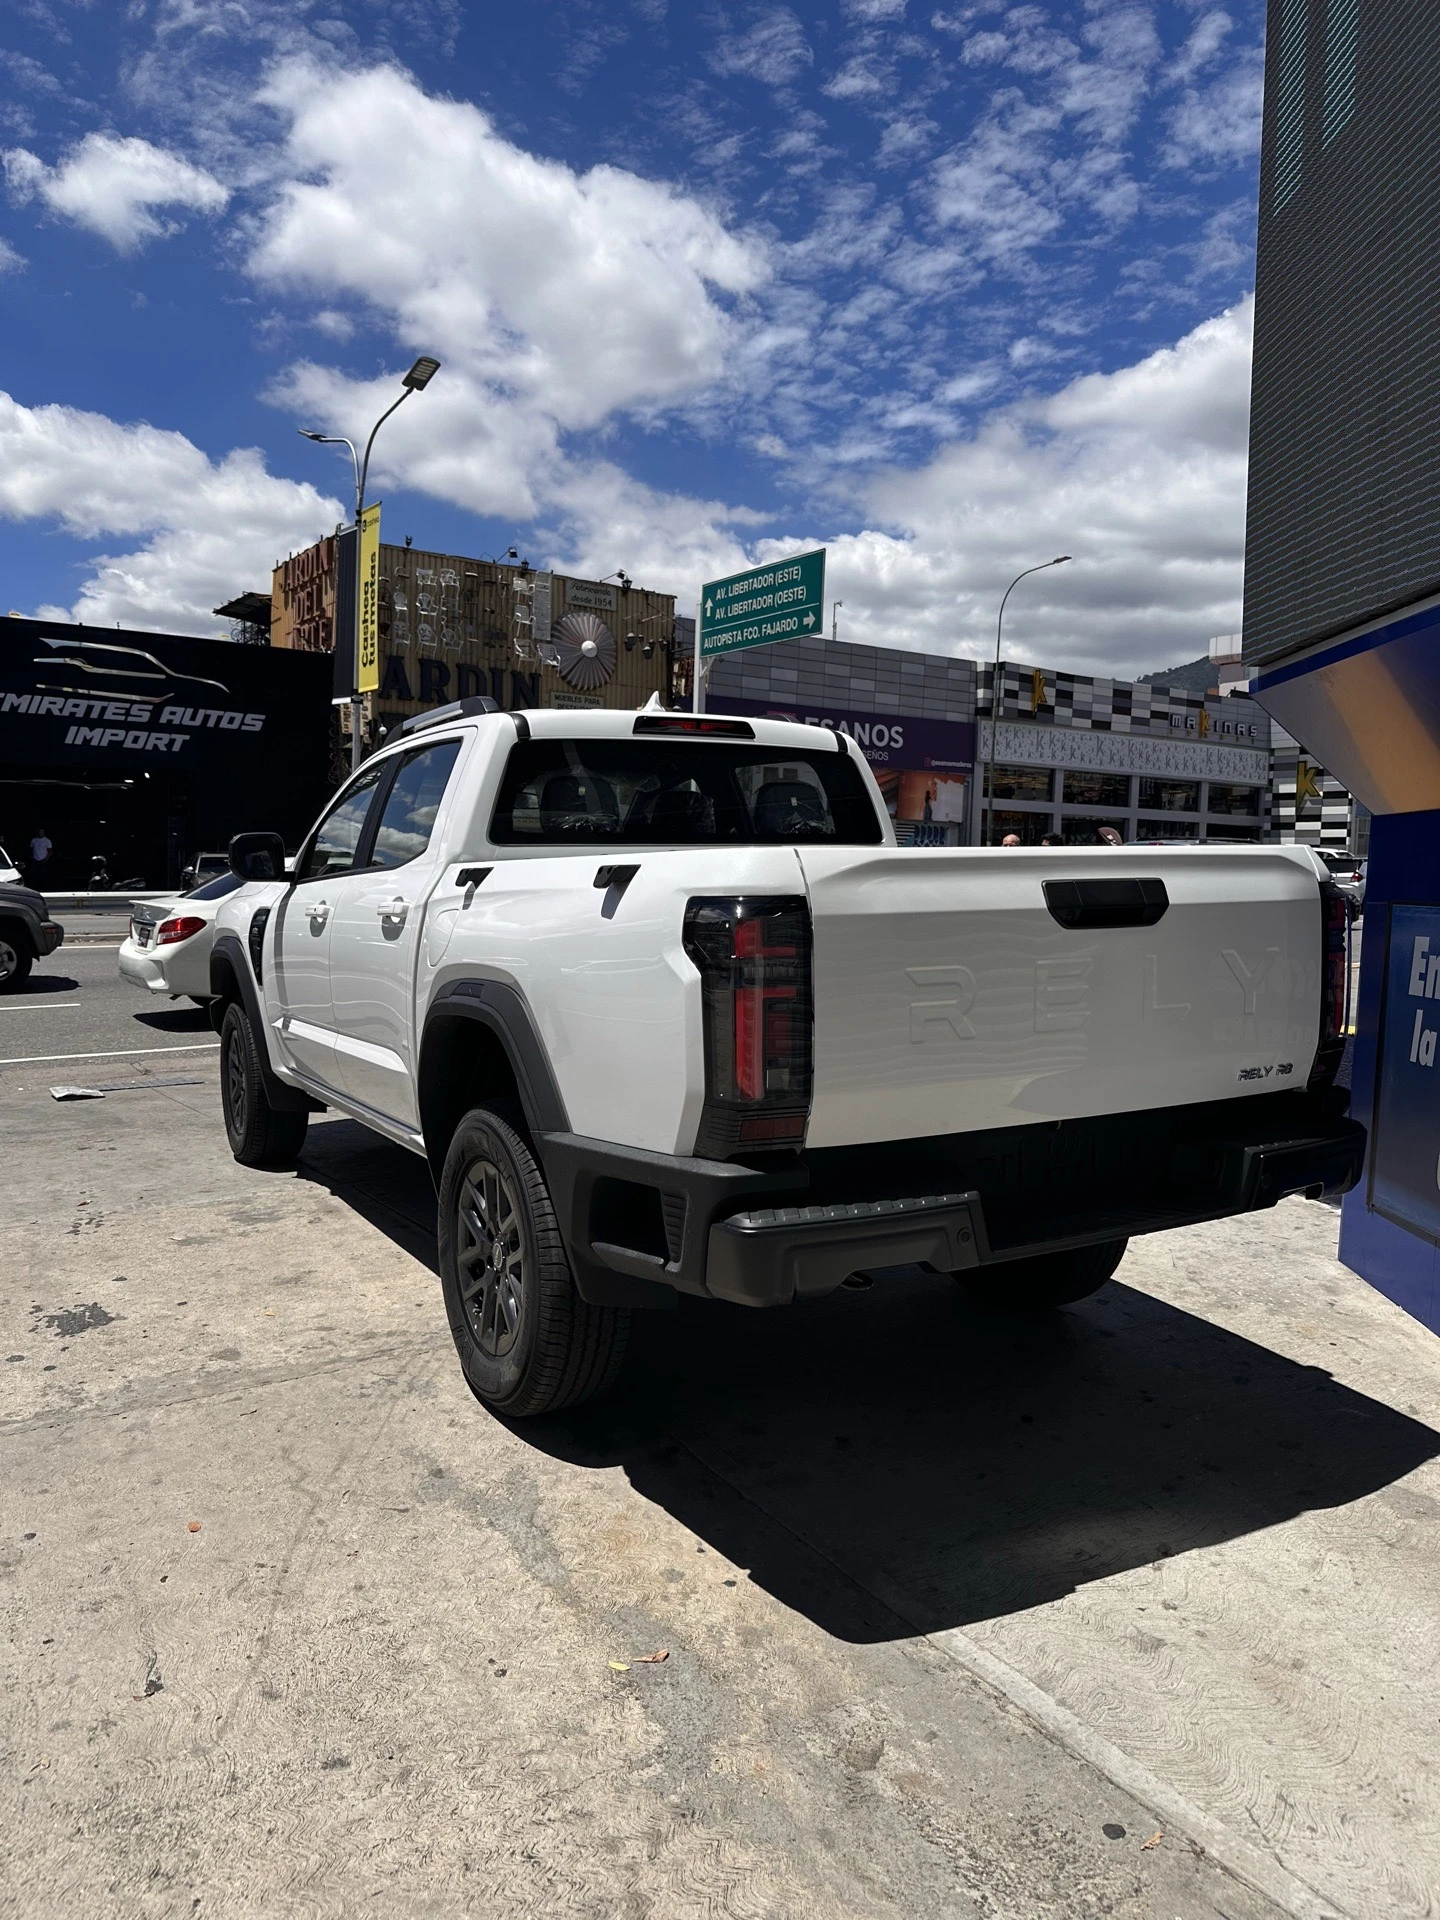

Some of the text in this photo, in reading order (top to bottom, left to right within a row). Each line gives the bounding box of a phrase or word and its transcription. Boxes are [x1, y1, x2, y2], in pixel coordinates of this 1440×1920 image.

[716, 565, 802, 600] AV. LIBERTADOR (ESTE)
[571, 594, 613, 607] desde 1954
[715, 585, 807, 620] AV. LIBERTADOR (OESTE)
[703, 617, 798, 649] AUTOPISTA FCO. FAJARDO
[379, 655, 542, 712] ARDIN
[554, 694, 601, 706] MUEBLES PARA
[159, 705, 266, 732] AUTOS
[64, 726, 190, 752] IMPORT
[906, 947, 1280, 1044] RELY
[1237, 1065, 1274, 1082] RELY
